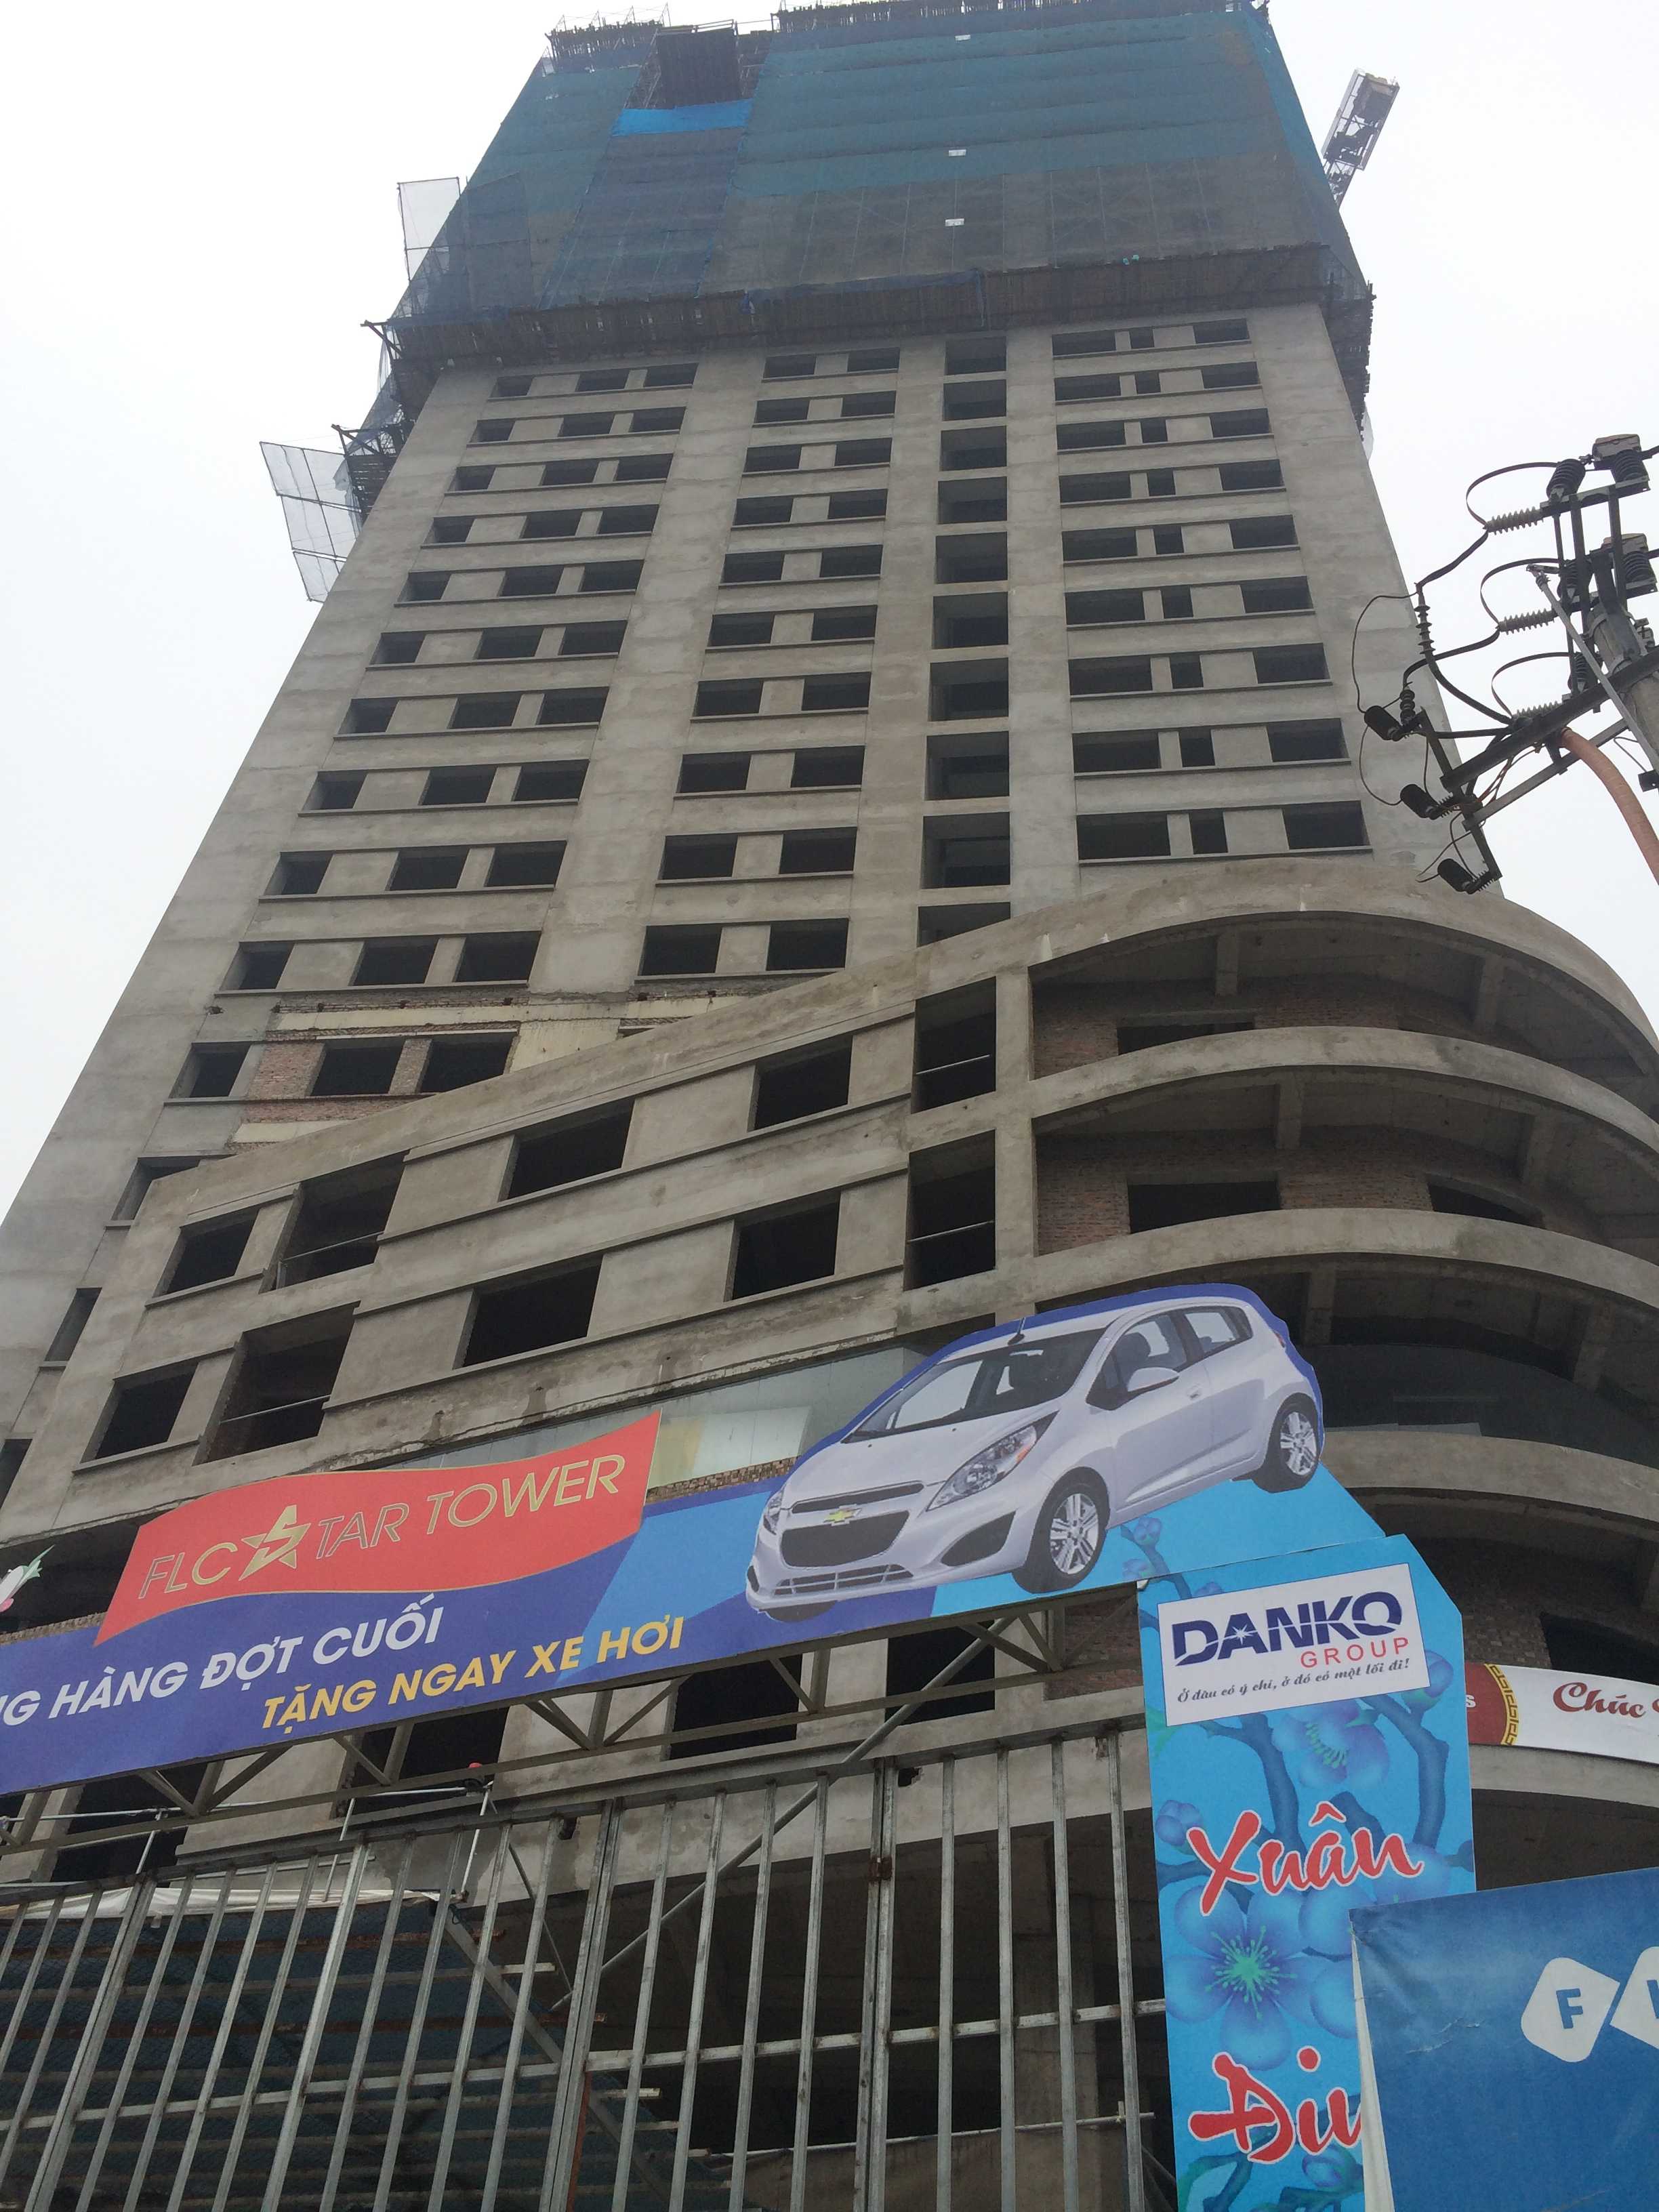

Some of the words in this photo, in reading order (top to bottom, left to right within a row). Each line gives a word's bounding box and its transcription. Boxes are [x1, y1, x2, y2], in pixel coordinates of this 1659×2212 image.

[138, 1542, 239, 1599] FLC
[426, 1454, 626, 1535] TOWER
[48, 1660, 189, 1719] HÀNG
[199, 1635, 304, 1692] ĐỢT
[312, 1593, 445, 1666] CUỐI
[262, 1679, 377, 1734] TẶNG
[387, 1649, 517, 1705] NGAY
[524, 1635, 585, 1679] XE
[596, 1612, 684, 1664] HƠI
[1171, 1591, 1402, 1667] DANKO
[1293, 1673, 1311, 1685] đó
[1315, 1670, 1330, 1682] có
[1334, 1666, 1361, 1680] một
[1366, 1662, 1385, 1675] lối
[1389, 1658, 1410, 1671] đi!
[1300, 1637, 1410, 1668] GROUP
[1553, 1681, 1647, 1719] Chúc
[1187, 1800, 1424, 1916] Xuân
